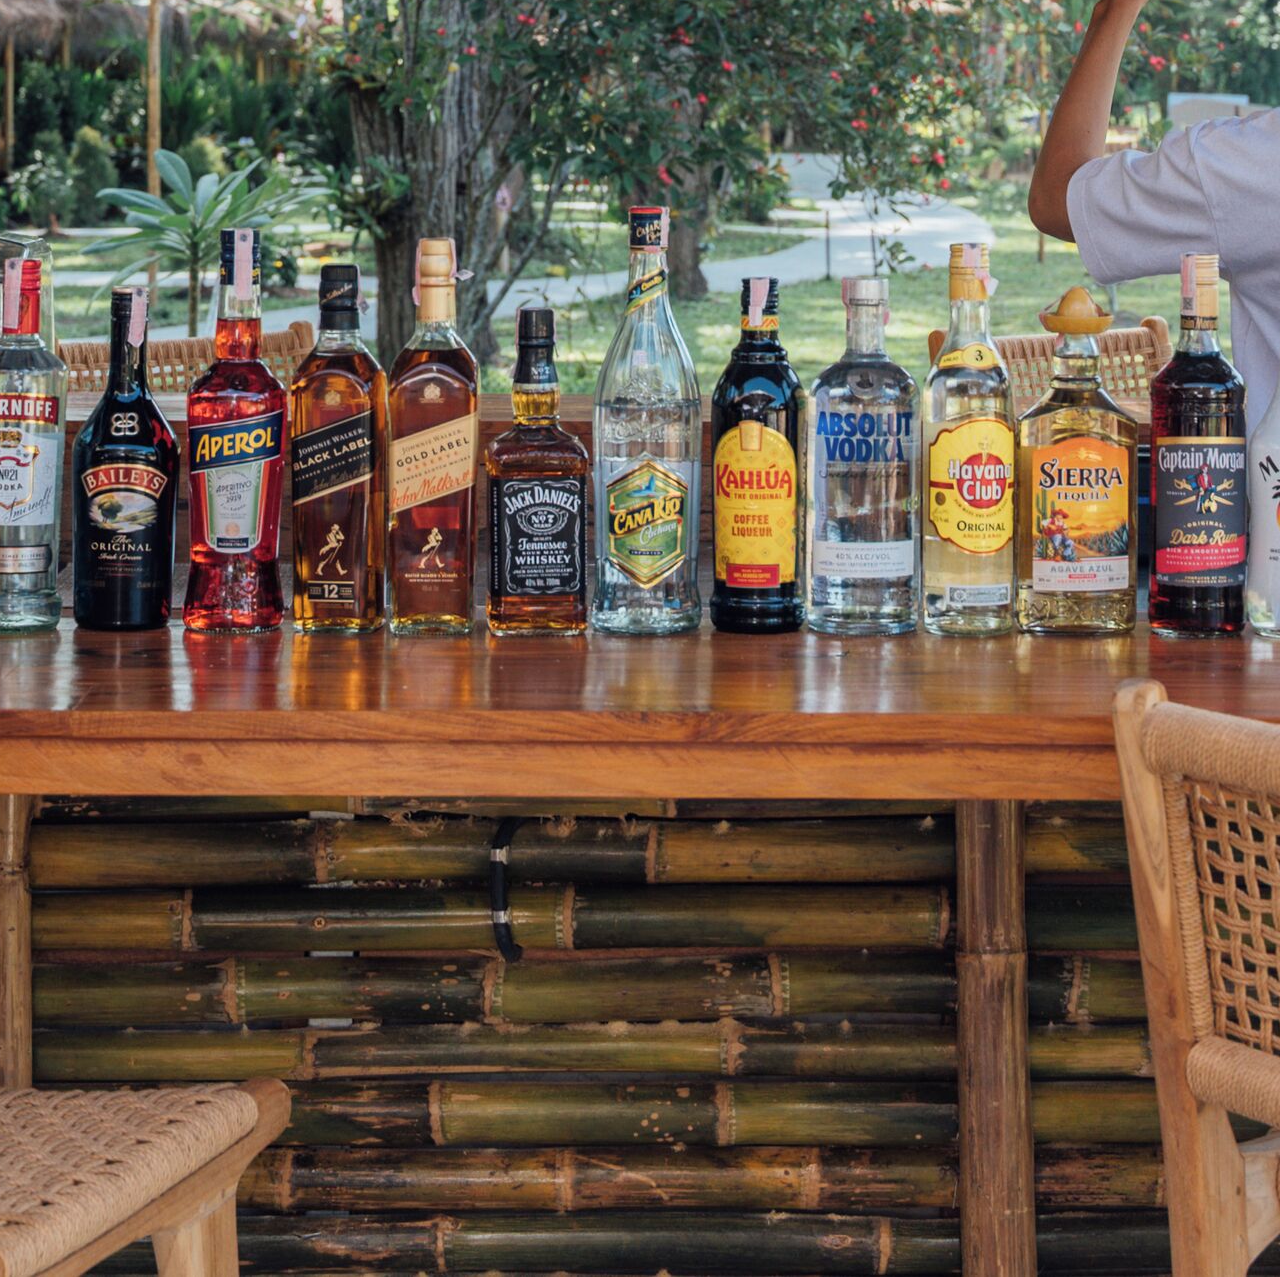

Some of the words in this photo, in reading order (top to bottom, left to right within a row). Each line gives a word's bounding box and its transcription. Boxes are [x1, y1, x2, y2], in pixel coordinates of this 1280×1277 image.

[975, 349, 984, 362] 3
[816, 411, 913, 438] ABSOLUT
[195, 426, 276, 463] APEROL
[292, 452, 331, 472] BLACK
[333, 436, 373, 457] LABEL
[298, 439, 332, 458] JOHNNIE
[396, 451, 429, 468] GOLD
[432, 437, 470, 456] LABEL
[824, 437, 905, 463] VODKA
[948, 458, 1012, 480] Havana
[1158, 446, 1204, 473] Captain
[85, 468, 164, 490] BAILEYS
[716, 463, 793, 499] KAHLÚA
[1039, 458, 1124, 489] SIERRA
[962, 480, 1003, 501] Club
[1057, 491, 1110, 501] TEQUILA
[504, 490, 533, 515] JACK
[733, 514, 769, 524] COFFEE
[956, 520, 1006, 532] ORIGINAL
[731, 526, 773, 538] LIQUEUR
[1169, 528, 1209, 545] Dark
[1209, 528, 1238, 547] Rum
[91, 542, 152, 552] ORIGINAL
[518, 537, 568, 551] Tennessee
[514, 554, 572, 566] WHISKEY
[1088, 564, 1113, 572] AZUL
[323, 584, 339, 599] 12
